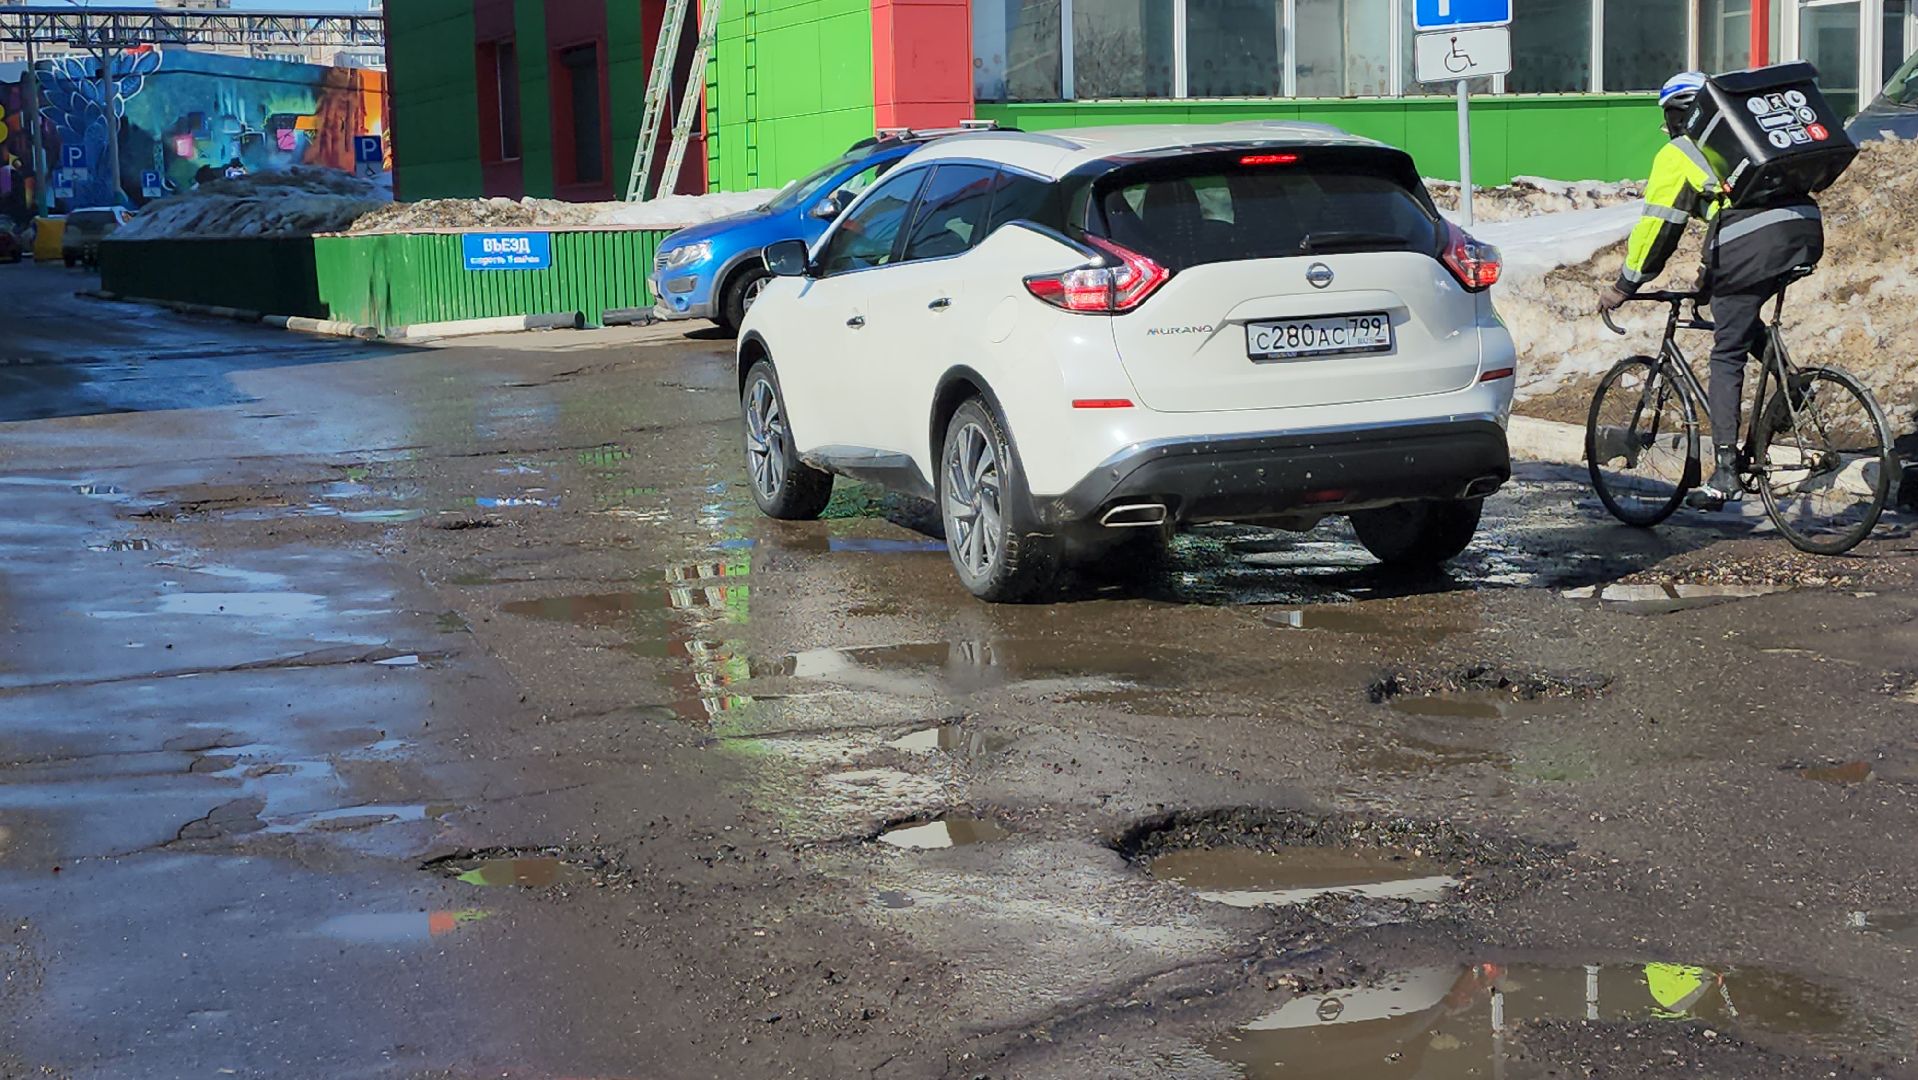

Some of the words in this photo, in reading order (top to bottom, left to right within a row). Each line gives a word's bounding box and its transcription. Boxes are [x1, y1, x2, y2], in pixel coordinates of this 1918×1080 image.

[69, 147, 82, 166] P
[362, 138, 377, 161] P
[146, 173, 156, 187] P
[483, 238, 531, 254] ВЪЕЗД
[1146, 324, 1213, 336] MURANO
[1348, 317, 1382, 338] 799
